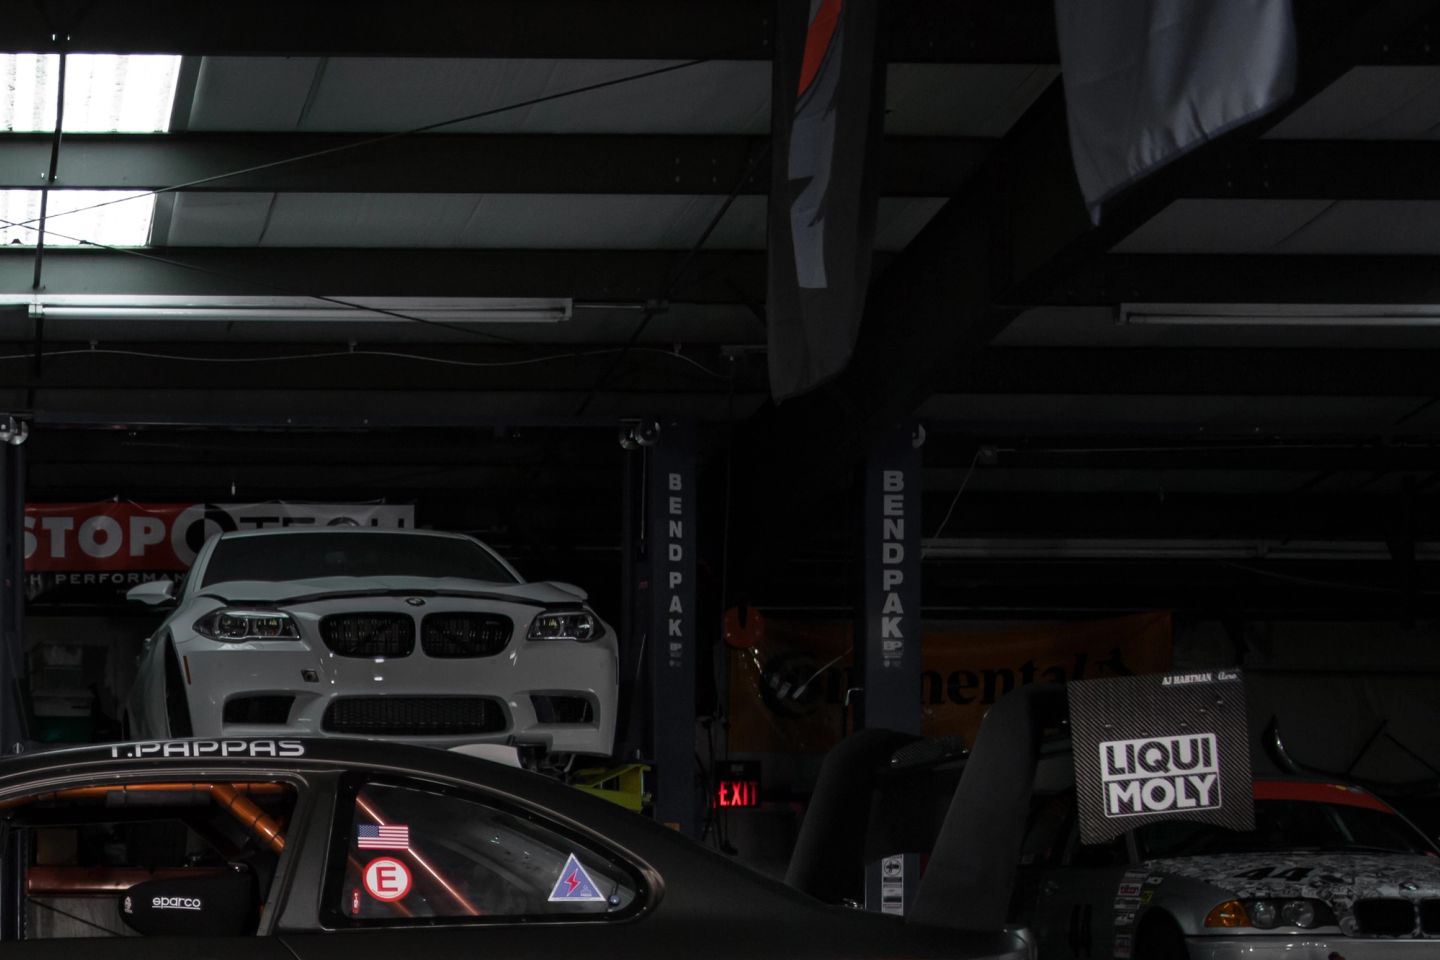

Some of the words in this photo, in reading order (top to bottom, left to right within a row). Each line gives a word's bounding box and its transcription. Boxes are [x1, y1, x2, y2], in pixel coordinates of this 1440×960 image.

[1106, 737, 1212, 775] LIQUI
[719, 780, 760, 806] EXIT
[1109, 773, 1217, 814] MOLY
[376, 866, 398, 892] E
